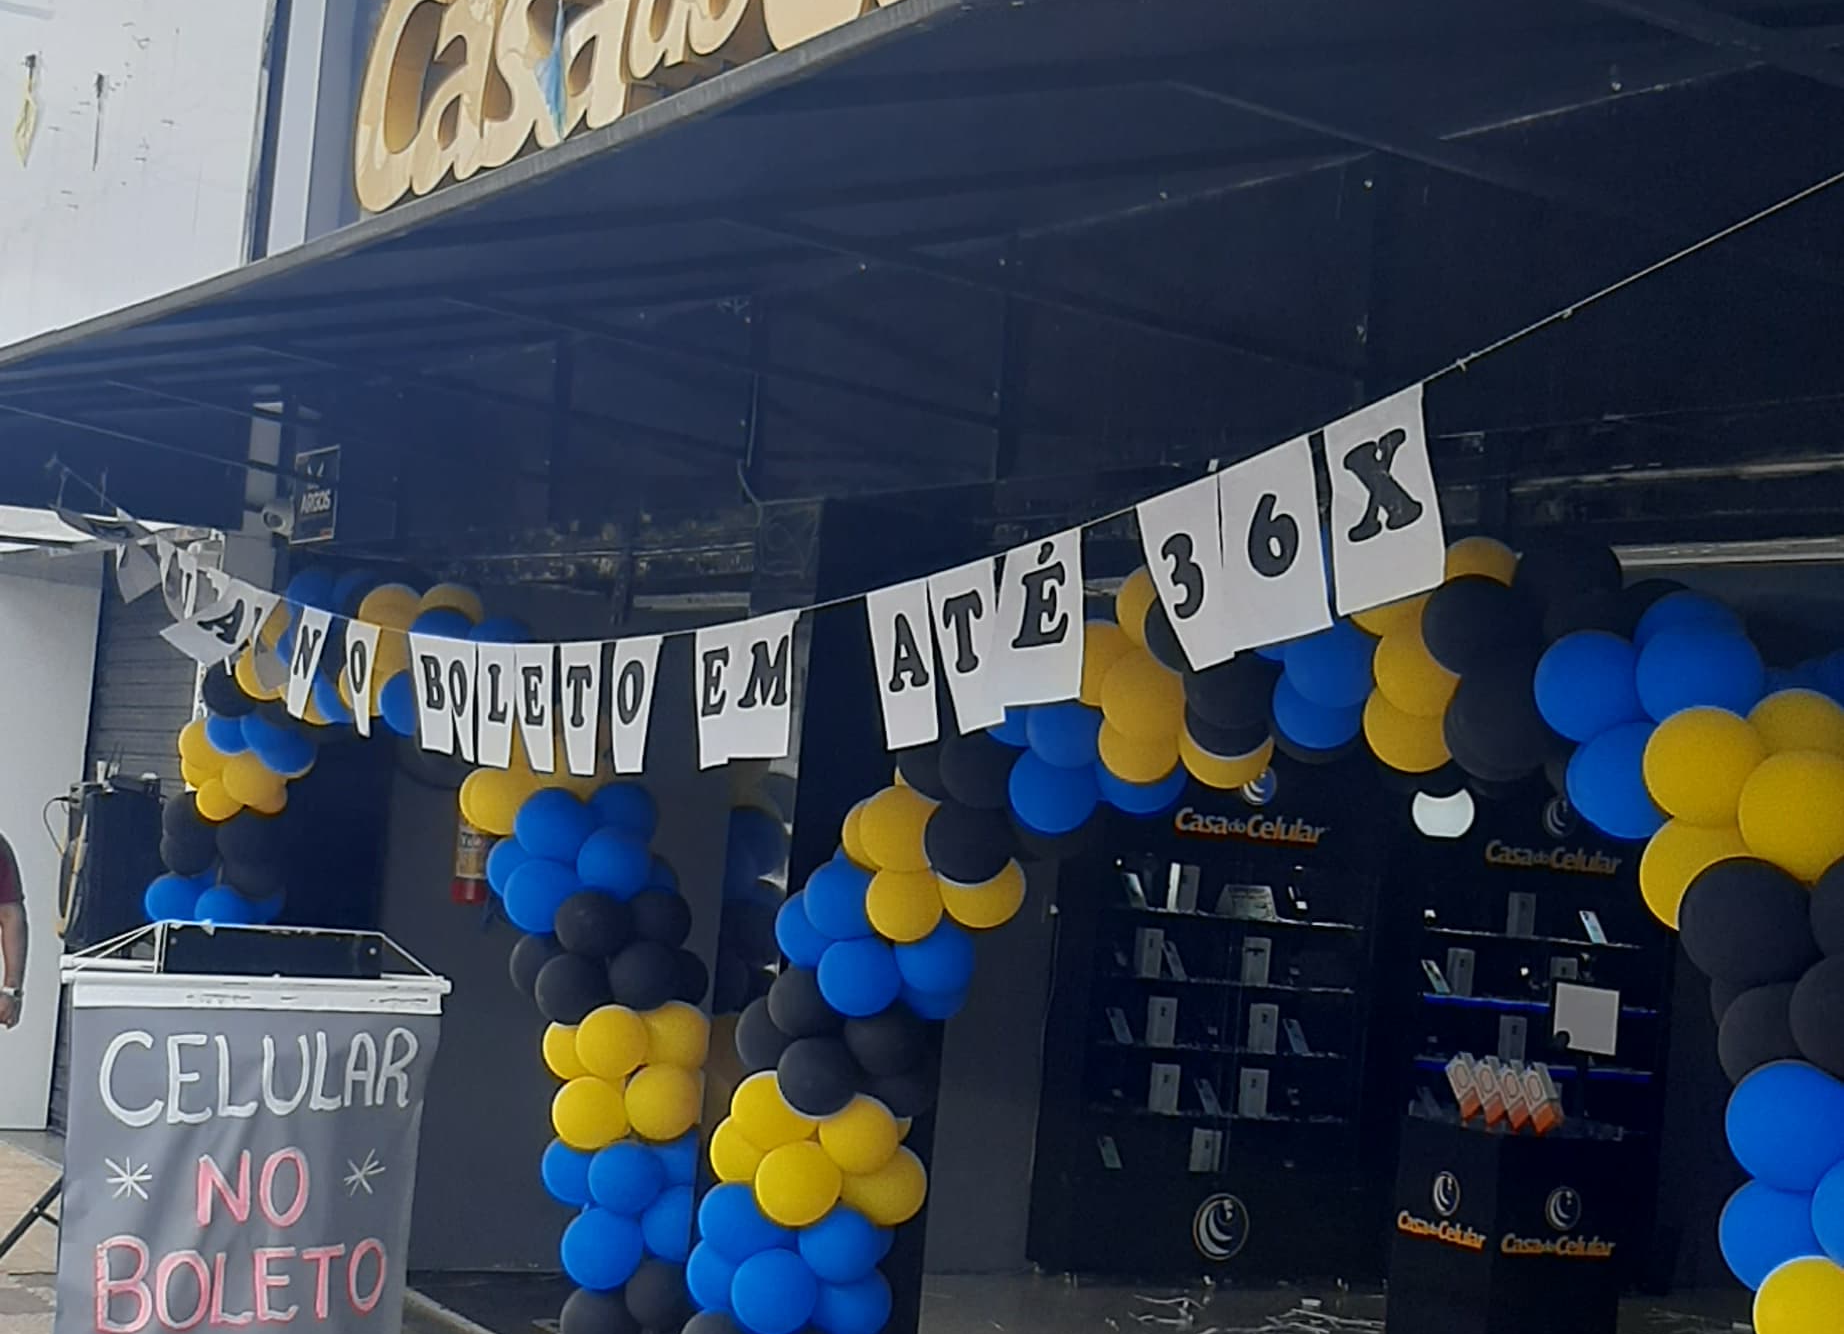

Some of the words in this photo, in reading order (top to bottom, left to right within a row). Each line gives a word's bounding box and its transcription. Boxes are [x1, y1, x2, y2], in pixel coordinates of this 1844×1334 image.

[292, 623, 368, 696] NO
[419, 653, 647, 729] BOLETO
[701, 635, 790, 718] EM
[888, 542, 1071, 693] ATÉ
[1174, 807, 1228, 836] Casa
[1246, 814, 1325, 845] Celular
[100, 1026, 420, 1128] CELULAR
[196, 1146, 311, 1229] NO
[95, 1234, 388, 1334] BOLETO
